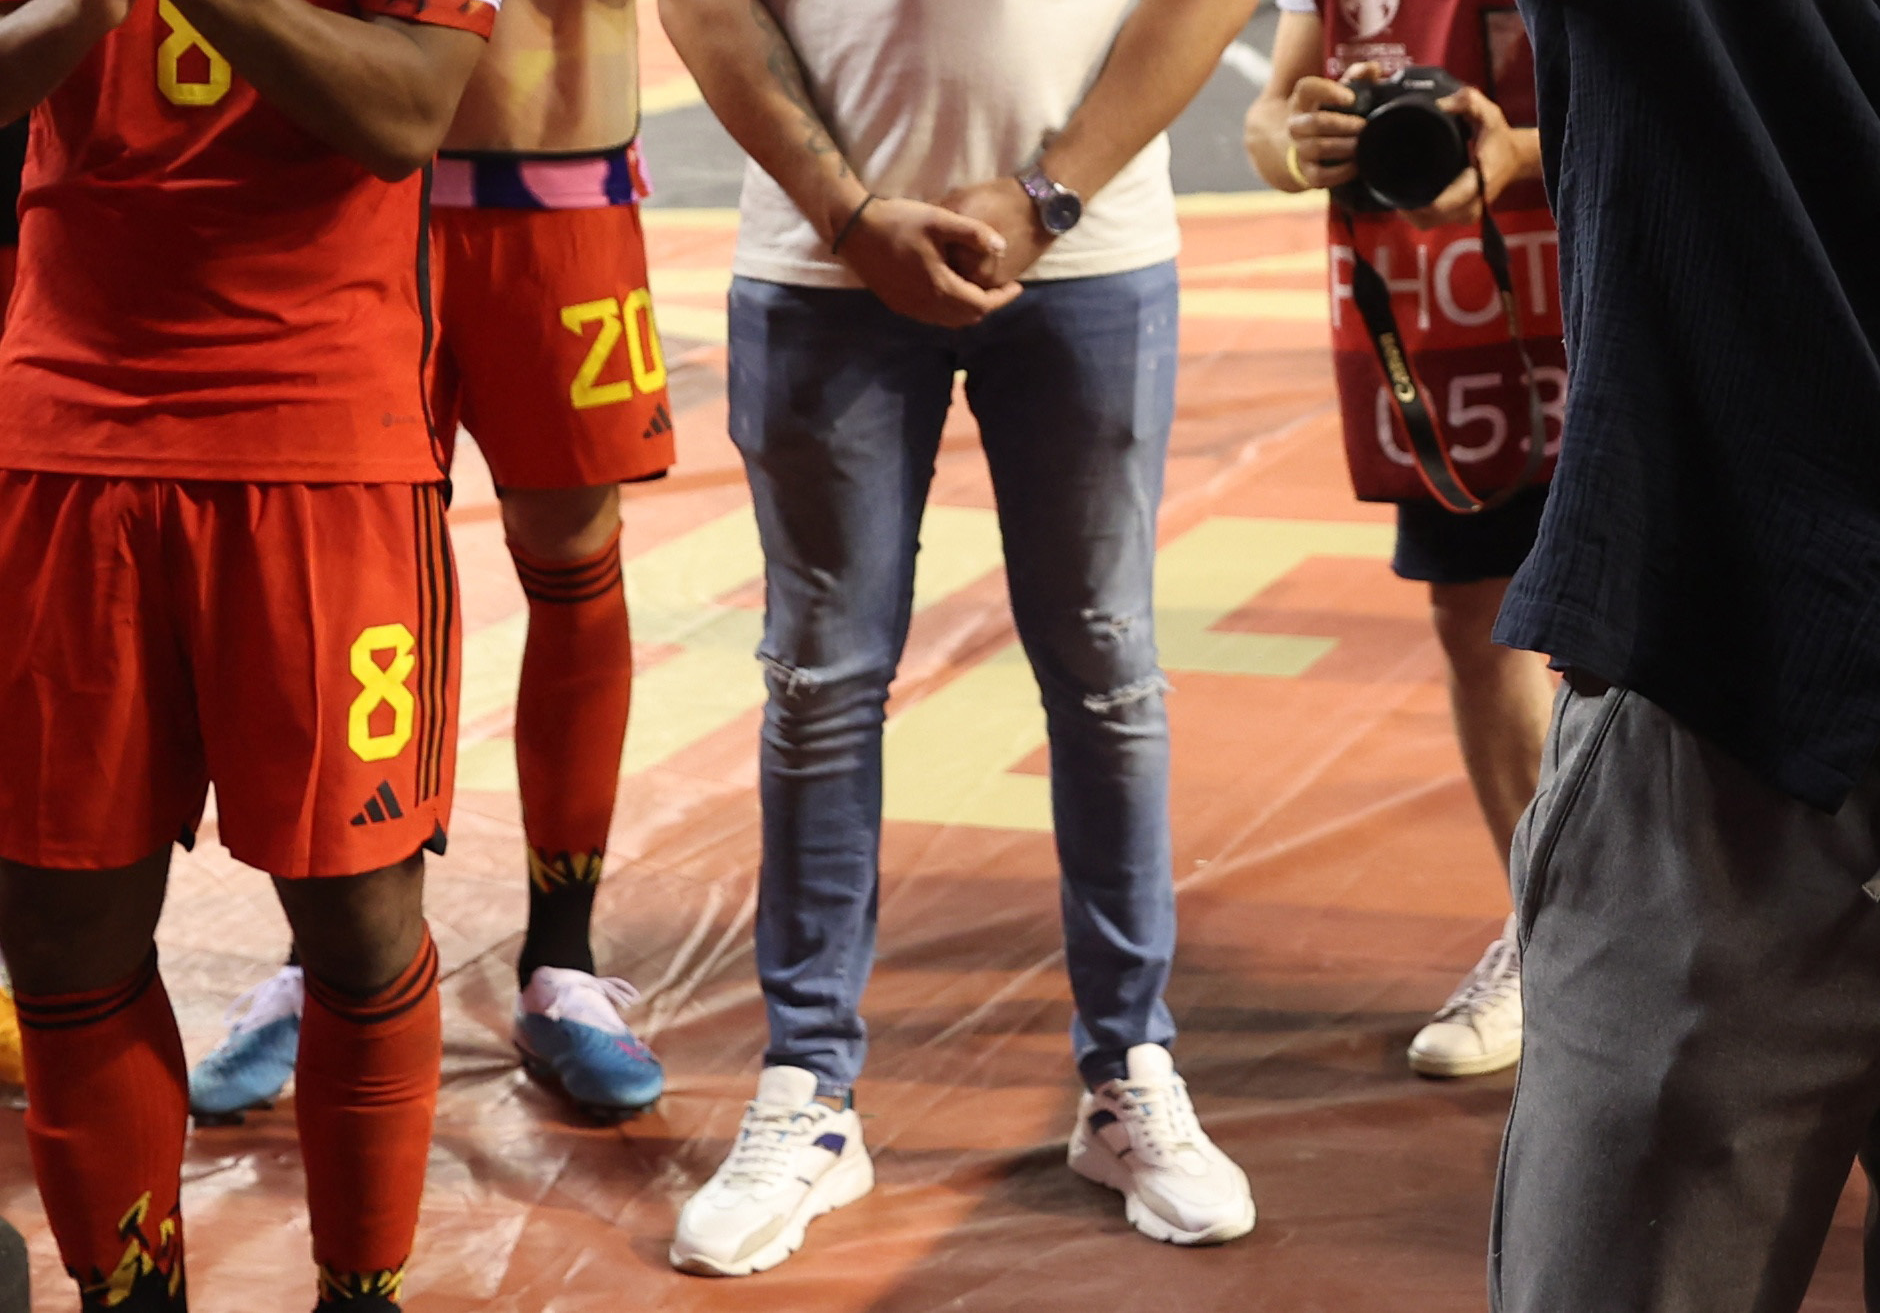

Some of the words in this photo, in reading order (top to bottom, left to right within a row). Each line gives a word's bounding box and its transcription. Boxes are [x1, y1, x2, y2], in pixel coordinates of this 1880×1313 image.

[1331, 230, 1559, 332] PHOT
[561, 287, 667, 409] 20
[347, 623, 416, 762] 8
